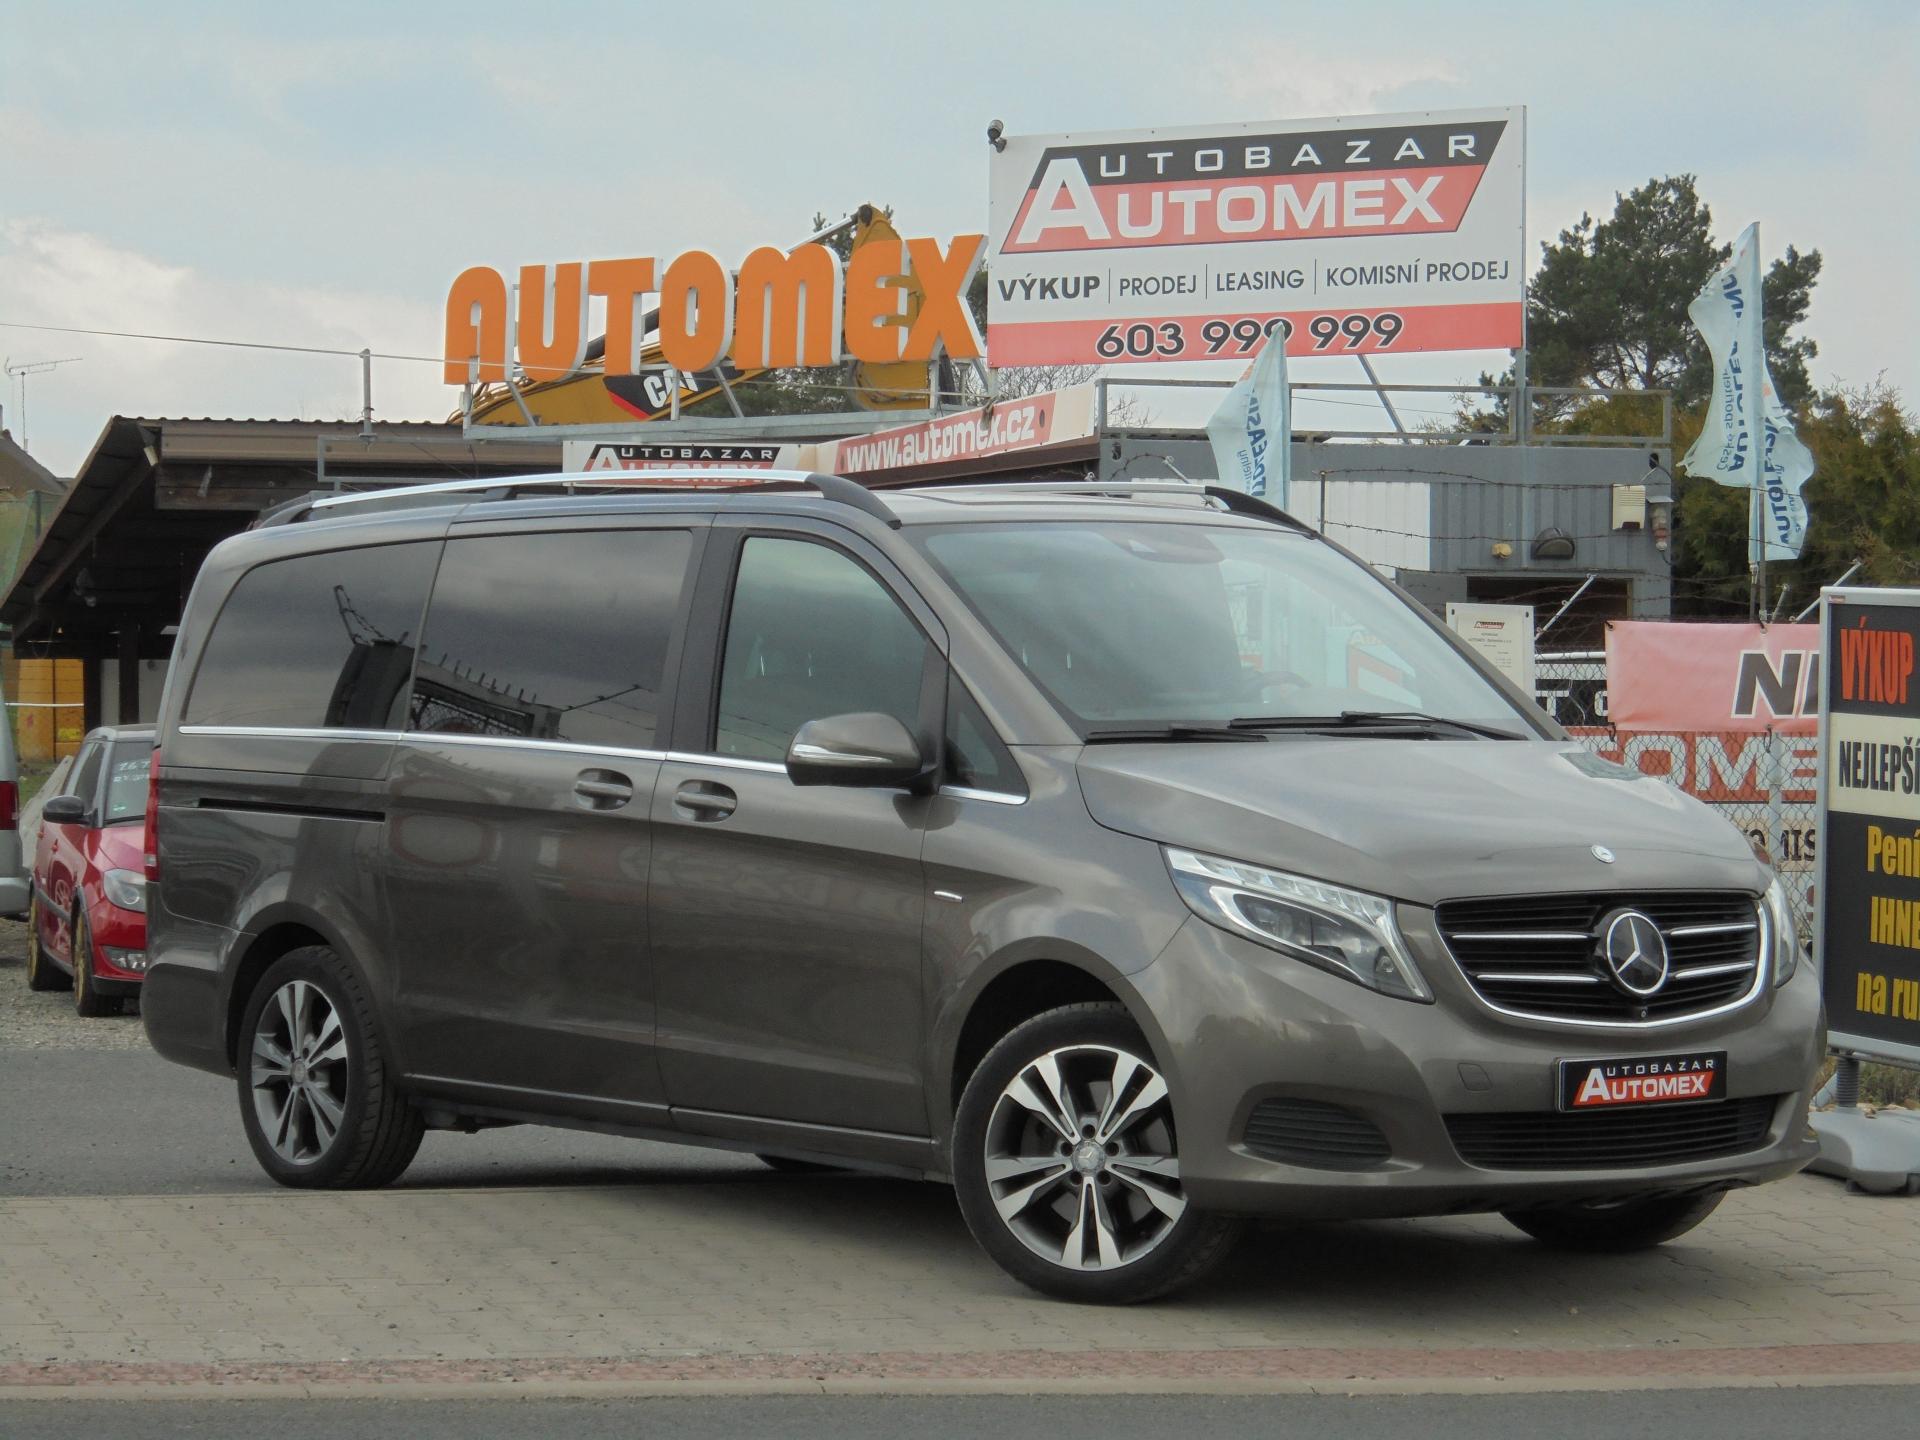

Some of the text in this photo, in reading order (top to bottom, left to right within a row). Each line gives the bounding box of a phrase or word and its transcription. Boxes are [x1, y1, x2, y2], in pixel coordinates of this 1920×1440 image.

[1015, 157, 1444, 244] AUTOMEX
[997, 258, 1509, 302] VÝKUP PRODEJ LEASING KOMISNÍ PRODEJ
[444, 234, 985, 385] AUTOMEX
[1096, 321, 1186, 359] 603
[1308, 312, 1404, 351] 999
[846, 405, 1035, 473] www.automex.cz
[1840, 615, 1914, 704] VÝKUP
[1856, 971, 1887, 1015] na
[1580, 1068, 1706, 1102] AUTOMEX
